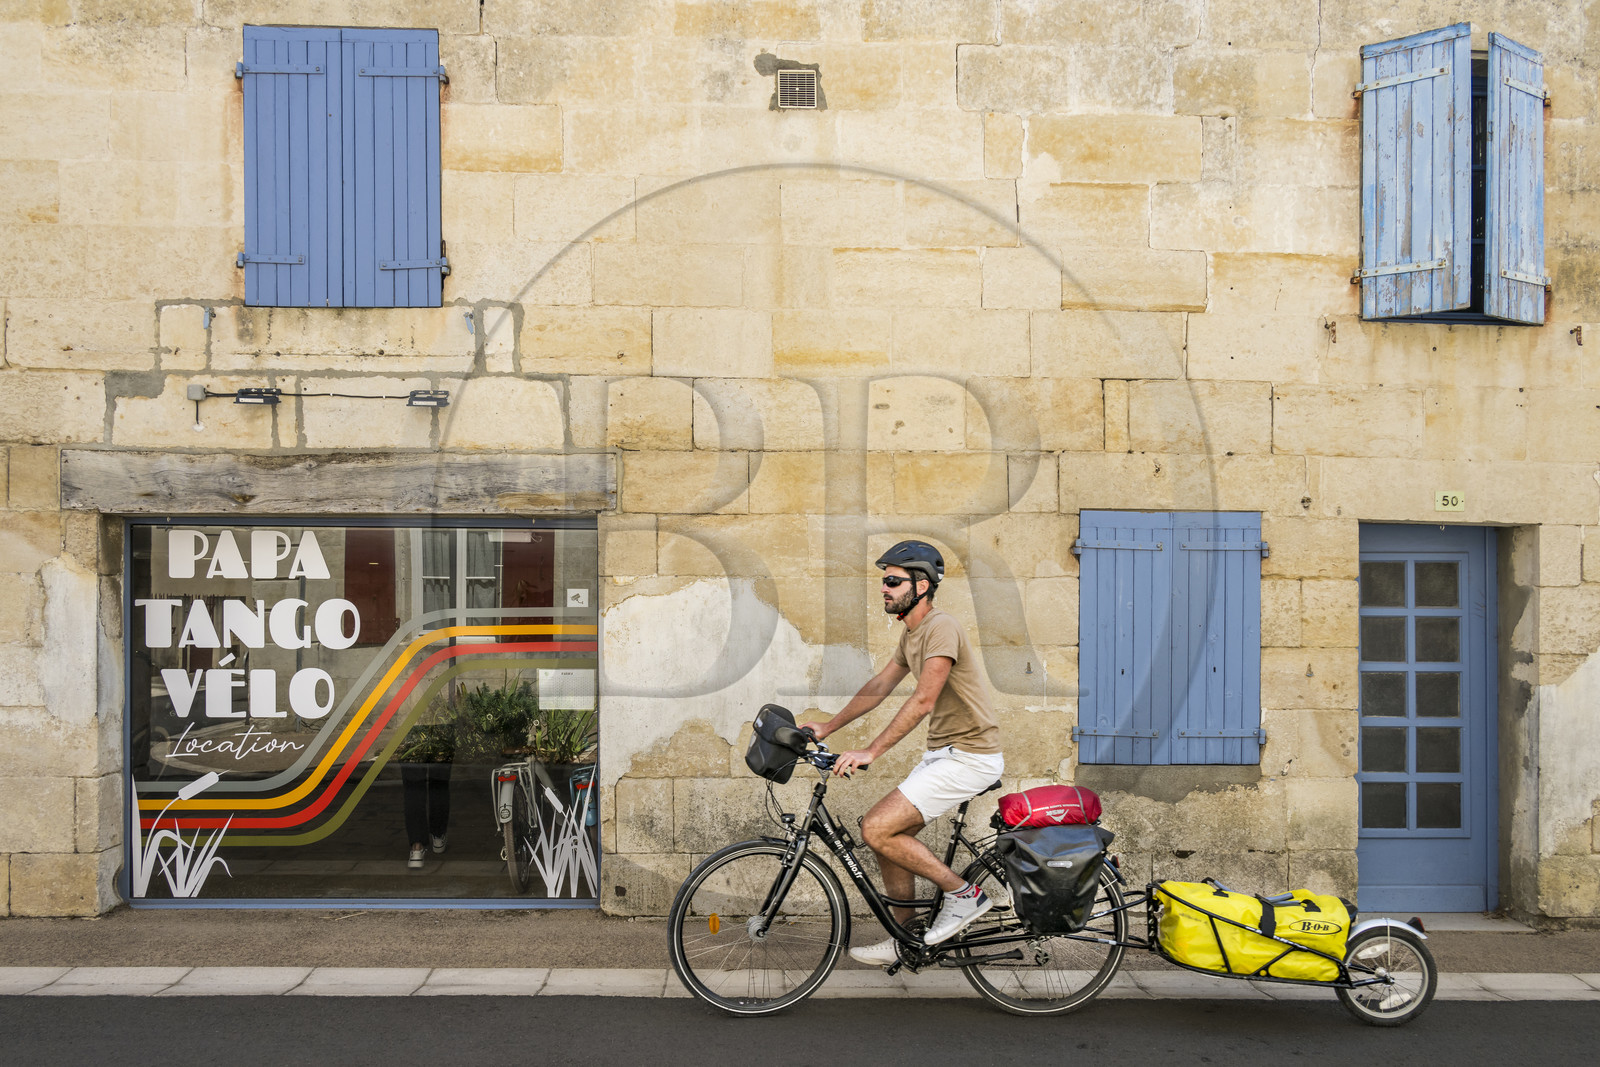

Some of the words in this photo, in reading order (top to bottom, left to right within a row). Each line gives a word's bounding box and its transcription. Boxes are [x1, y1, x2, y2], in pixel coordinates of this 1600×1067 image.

[1442, 495, 1459, 507] 50
[168, 529, 330, 579] PAPA
[135, 598, 361, 650] TANGO
[160, 652, 335, 719] VÉLO
[165, 721, 305, 760] Location
